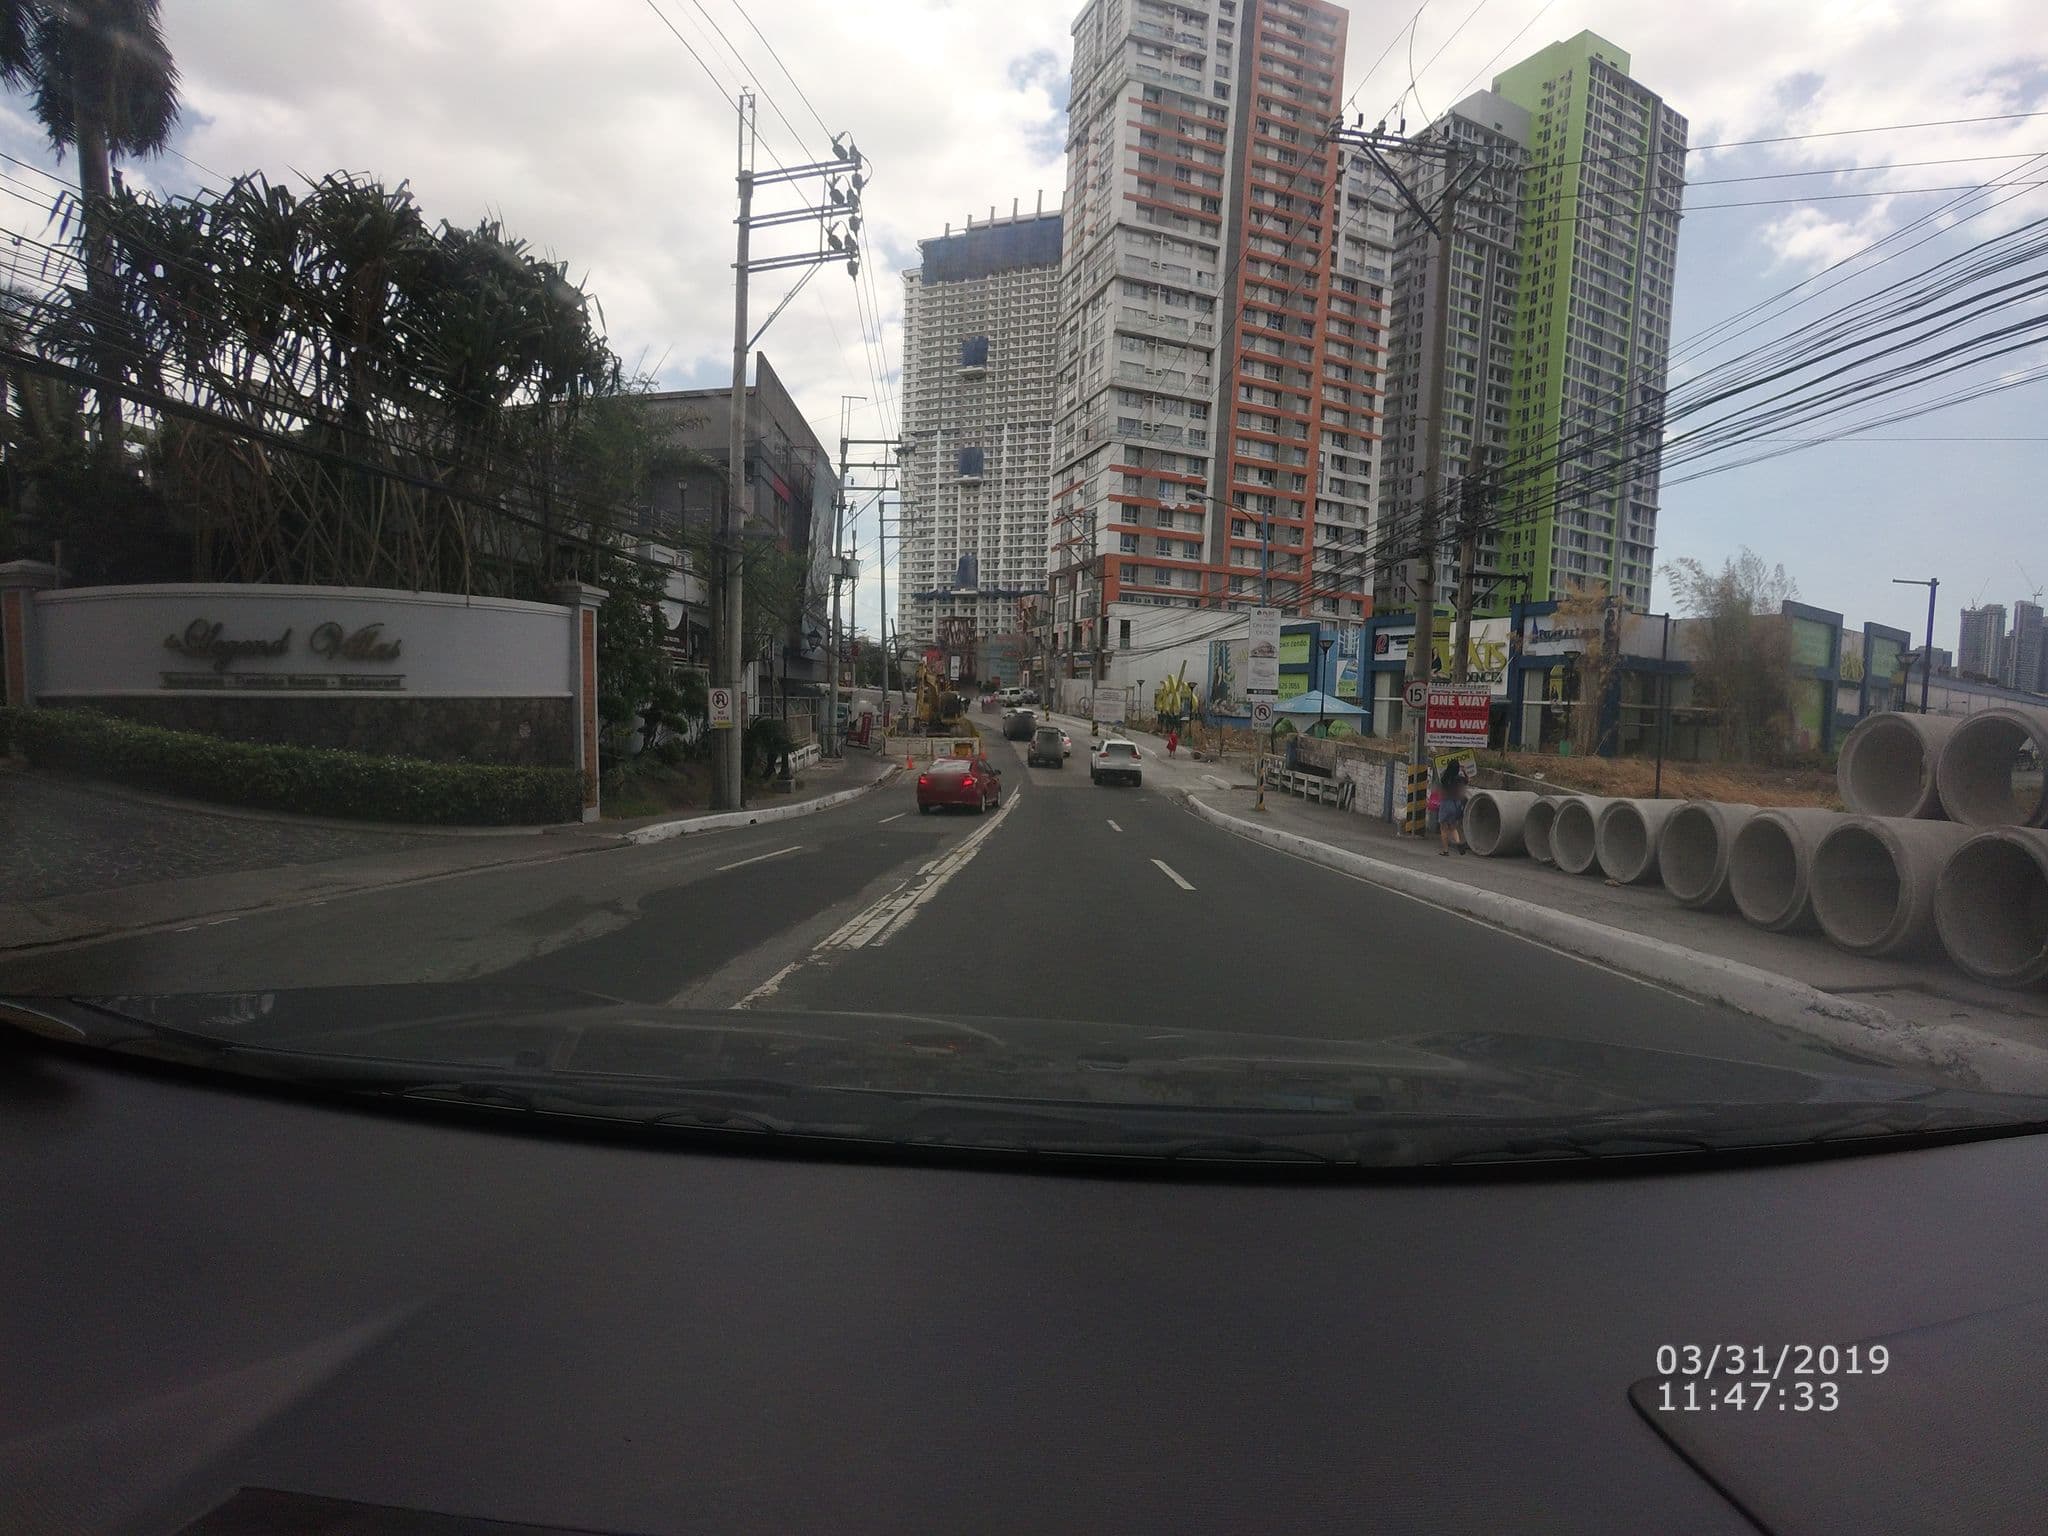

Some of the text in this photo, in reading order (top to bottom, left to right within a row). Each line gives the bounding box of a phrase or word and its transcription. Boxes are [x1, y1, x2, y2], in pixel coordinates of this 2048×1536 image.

[1430, 695, 1488, 707] ONE WAY
[1428, 718, 1488, 730] TWO WAY
